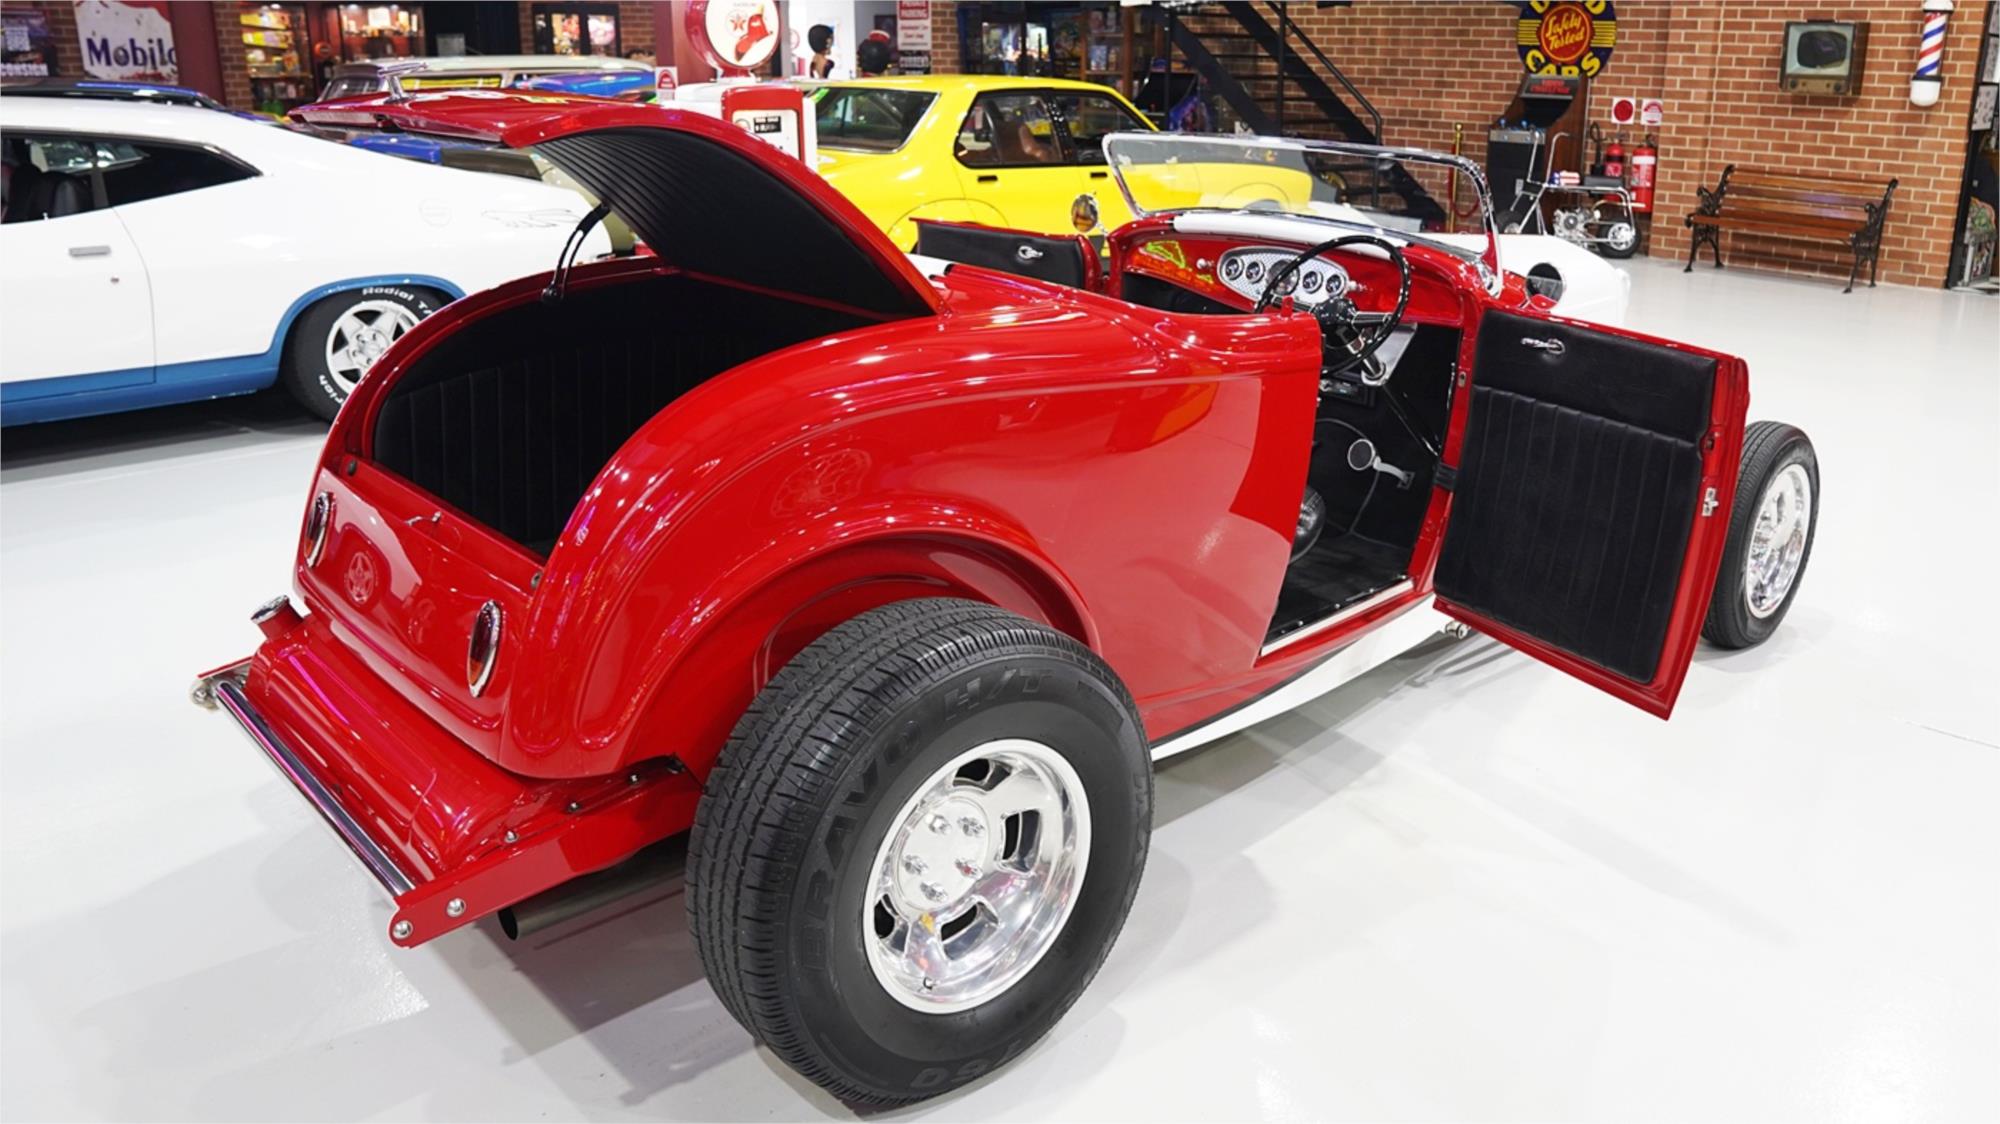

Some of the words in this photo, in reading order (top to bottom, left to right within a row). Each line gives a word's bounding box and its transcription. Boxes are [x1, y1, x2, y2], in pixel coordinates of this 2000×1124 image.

[1545, 12, 1582, 38] Safety
[1548, 26, 1586, 51] Tested
[362, 286, 415, 301] Radial
[802, 719, 922, 971] BRAVO
[944, 667, 1054, 721] H/T
